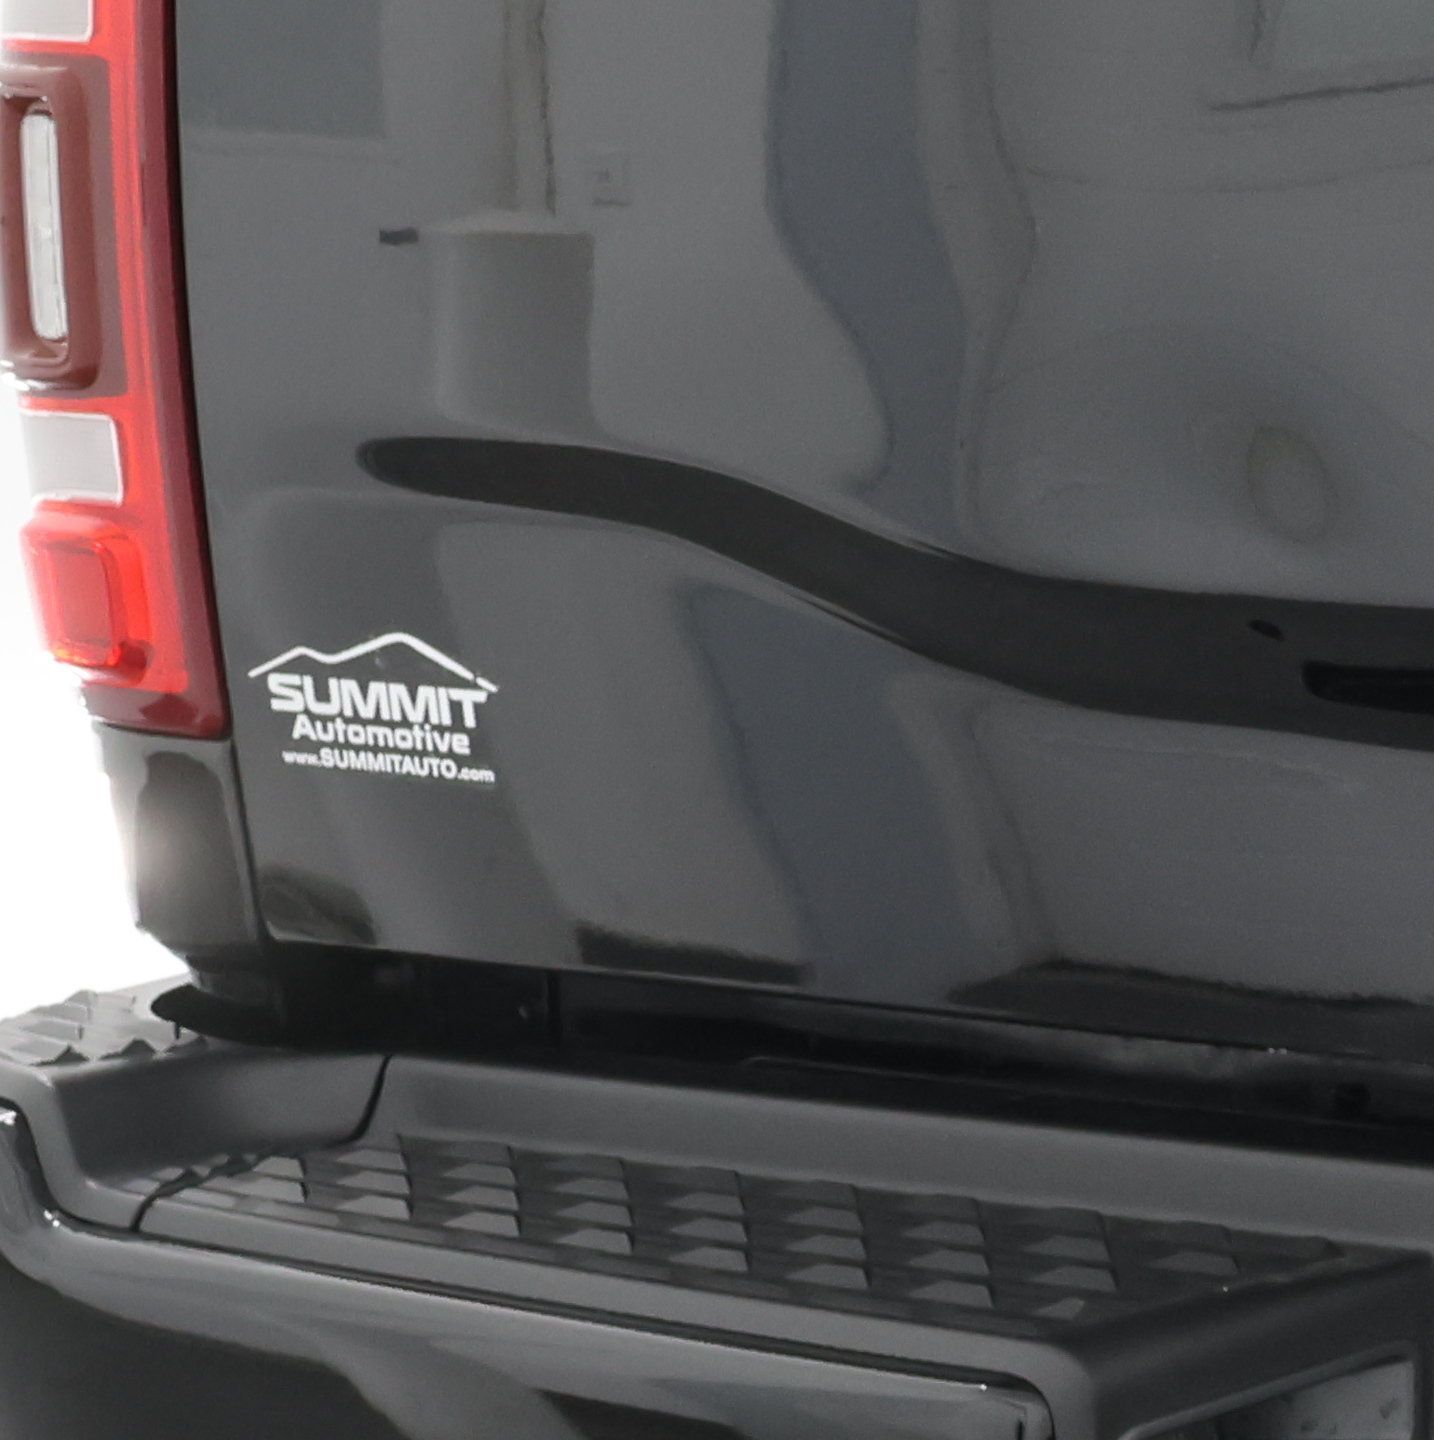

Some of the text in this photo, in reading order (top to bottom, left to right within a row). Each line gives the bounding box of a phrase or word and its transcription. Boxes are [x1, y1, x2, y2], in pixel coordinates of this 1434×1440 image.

[266, 671, 489, 729] SUMMIT
[291, 713, 472, 756] Automotive
[281, 746, 497, 784] www.SUMMITAUTO.com
